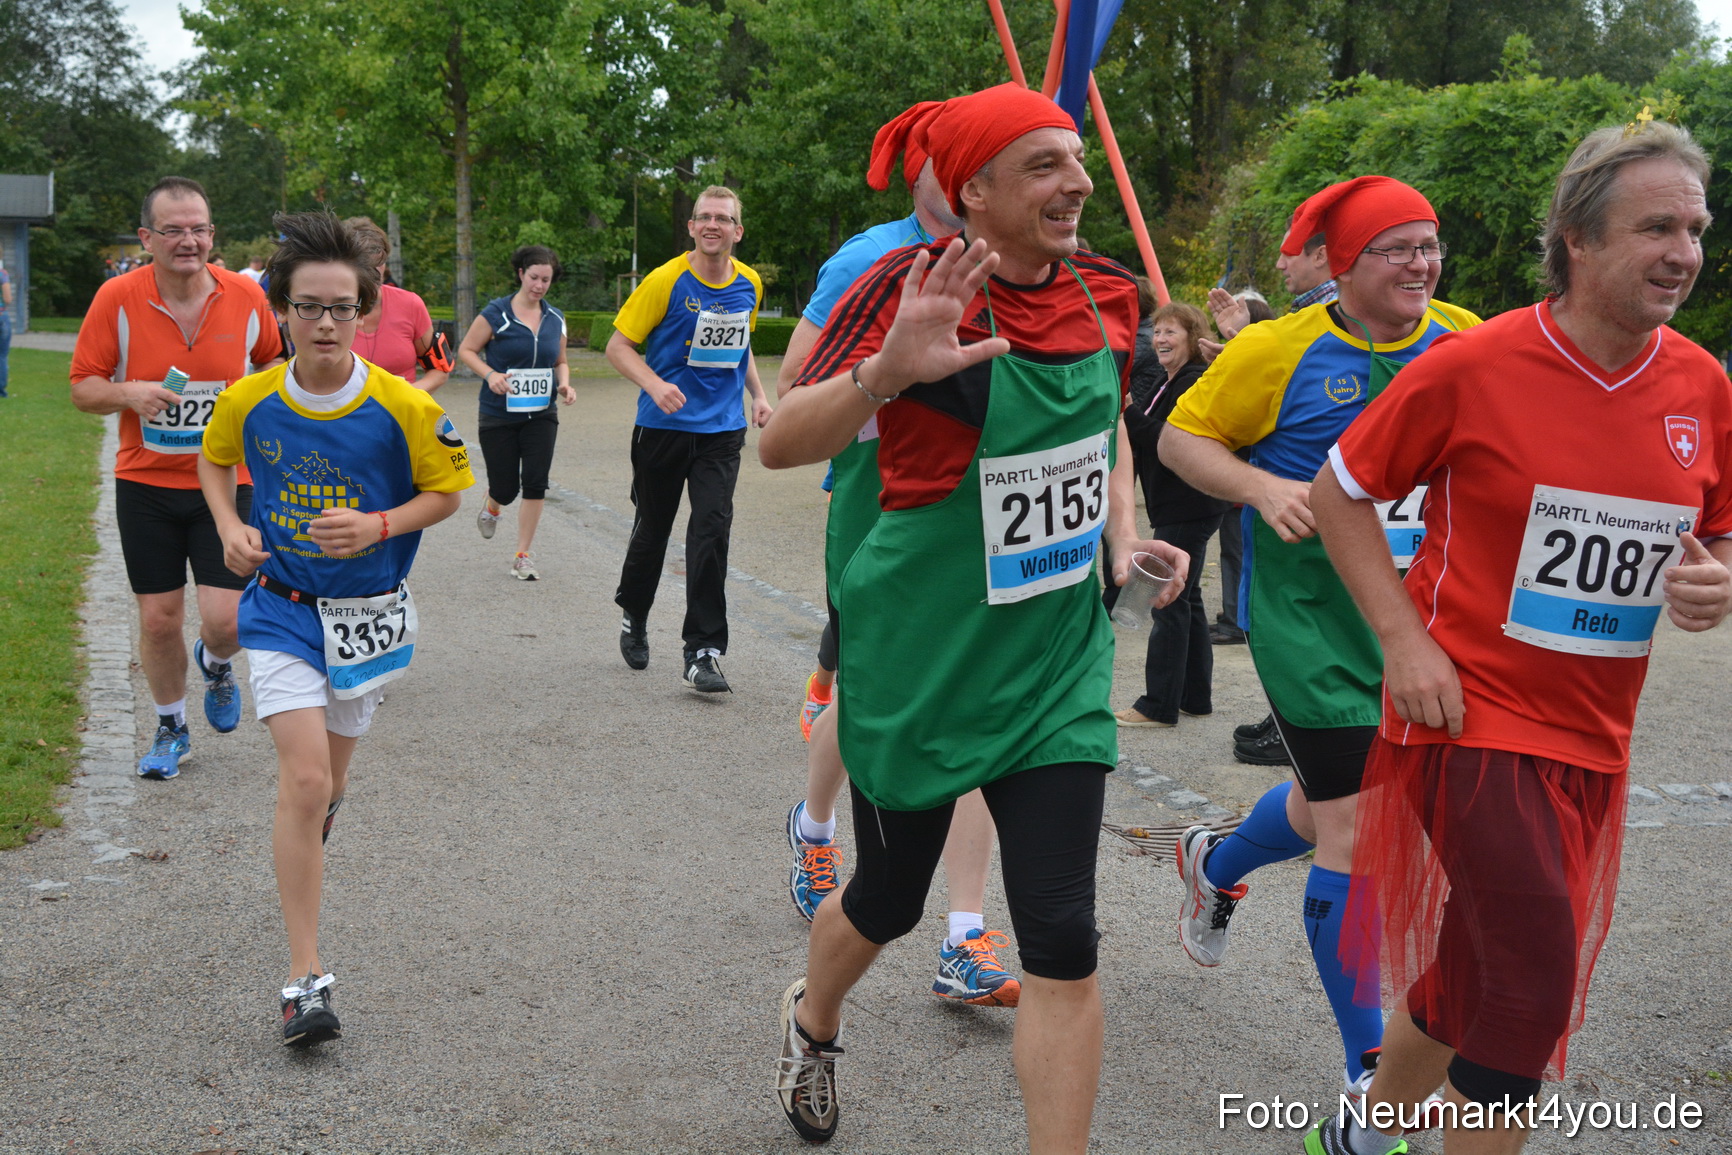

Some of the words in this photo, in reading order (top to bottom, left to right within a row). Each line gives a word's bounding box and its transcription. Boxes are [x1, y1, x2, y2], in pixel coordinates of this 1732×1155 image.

[700, 317, 720, 325] PARTL
[700, 326, 745, 346] 3321
[512, 379, 548, 395] 3409
[160, 433, 203, 445] Andreas
[1670, 423, 1695, 432] SUISSE
[985, 466, 1038, 487] PARTL
[1041, 451, 1098, 479] Neumarkt
[1002, 468, 1103, 546] 2153
[1535, 502, 1591, 524] PARTL
[1596, 511, 1671, 535] Neumarkt
[992, 544, 999, 553] D
[1020, 540, 1094, 579] Wolfgang
[1535, 529, 1675, 598] 2087
[321, 607, 358, 617] PARTL
[1572, 608, 1619, 635] Reto
[333, 607, 406, 660] 3357
